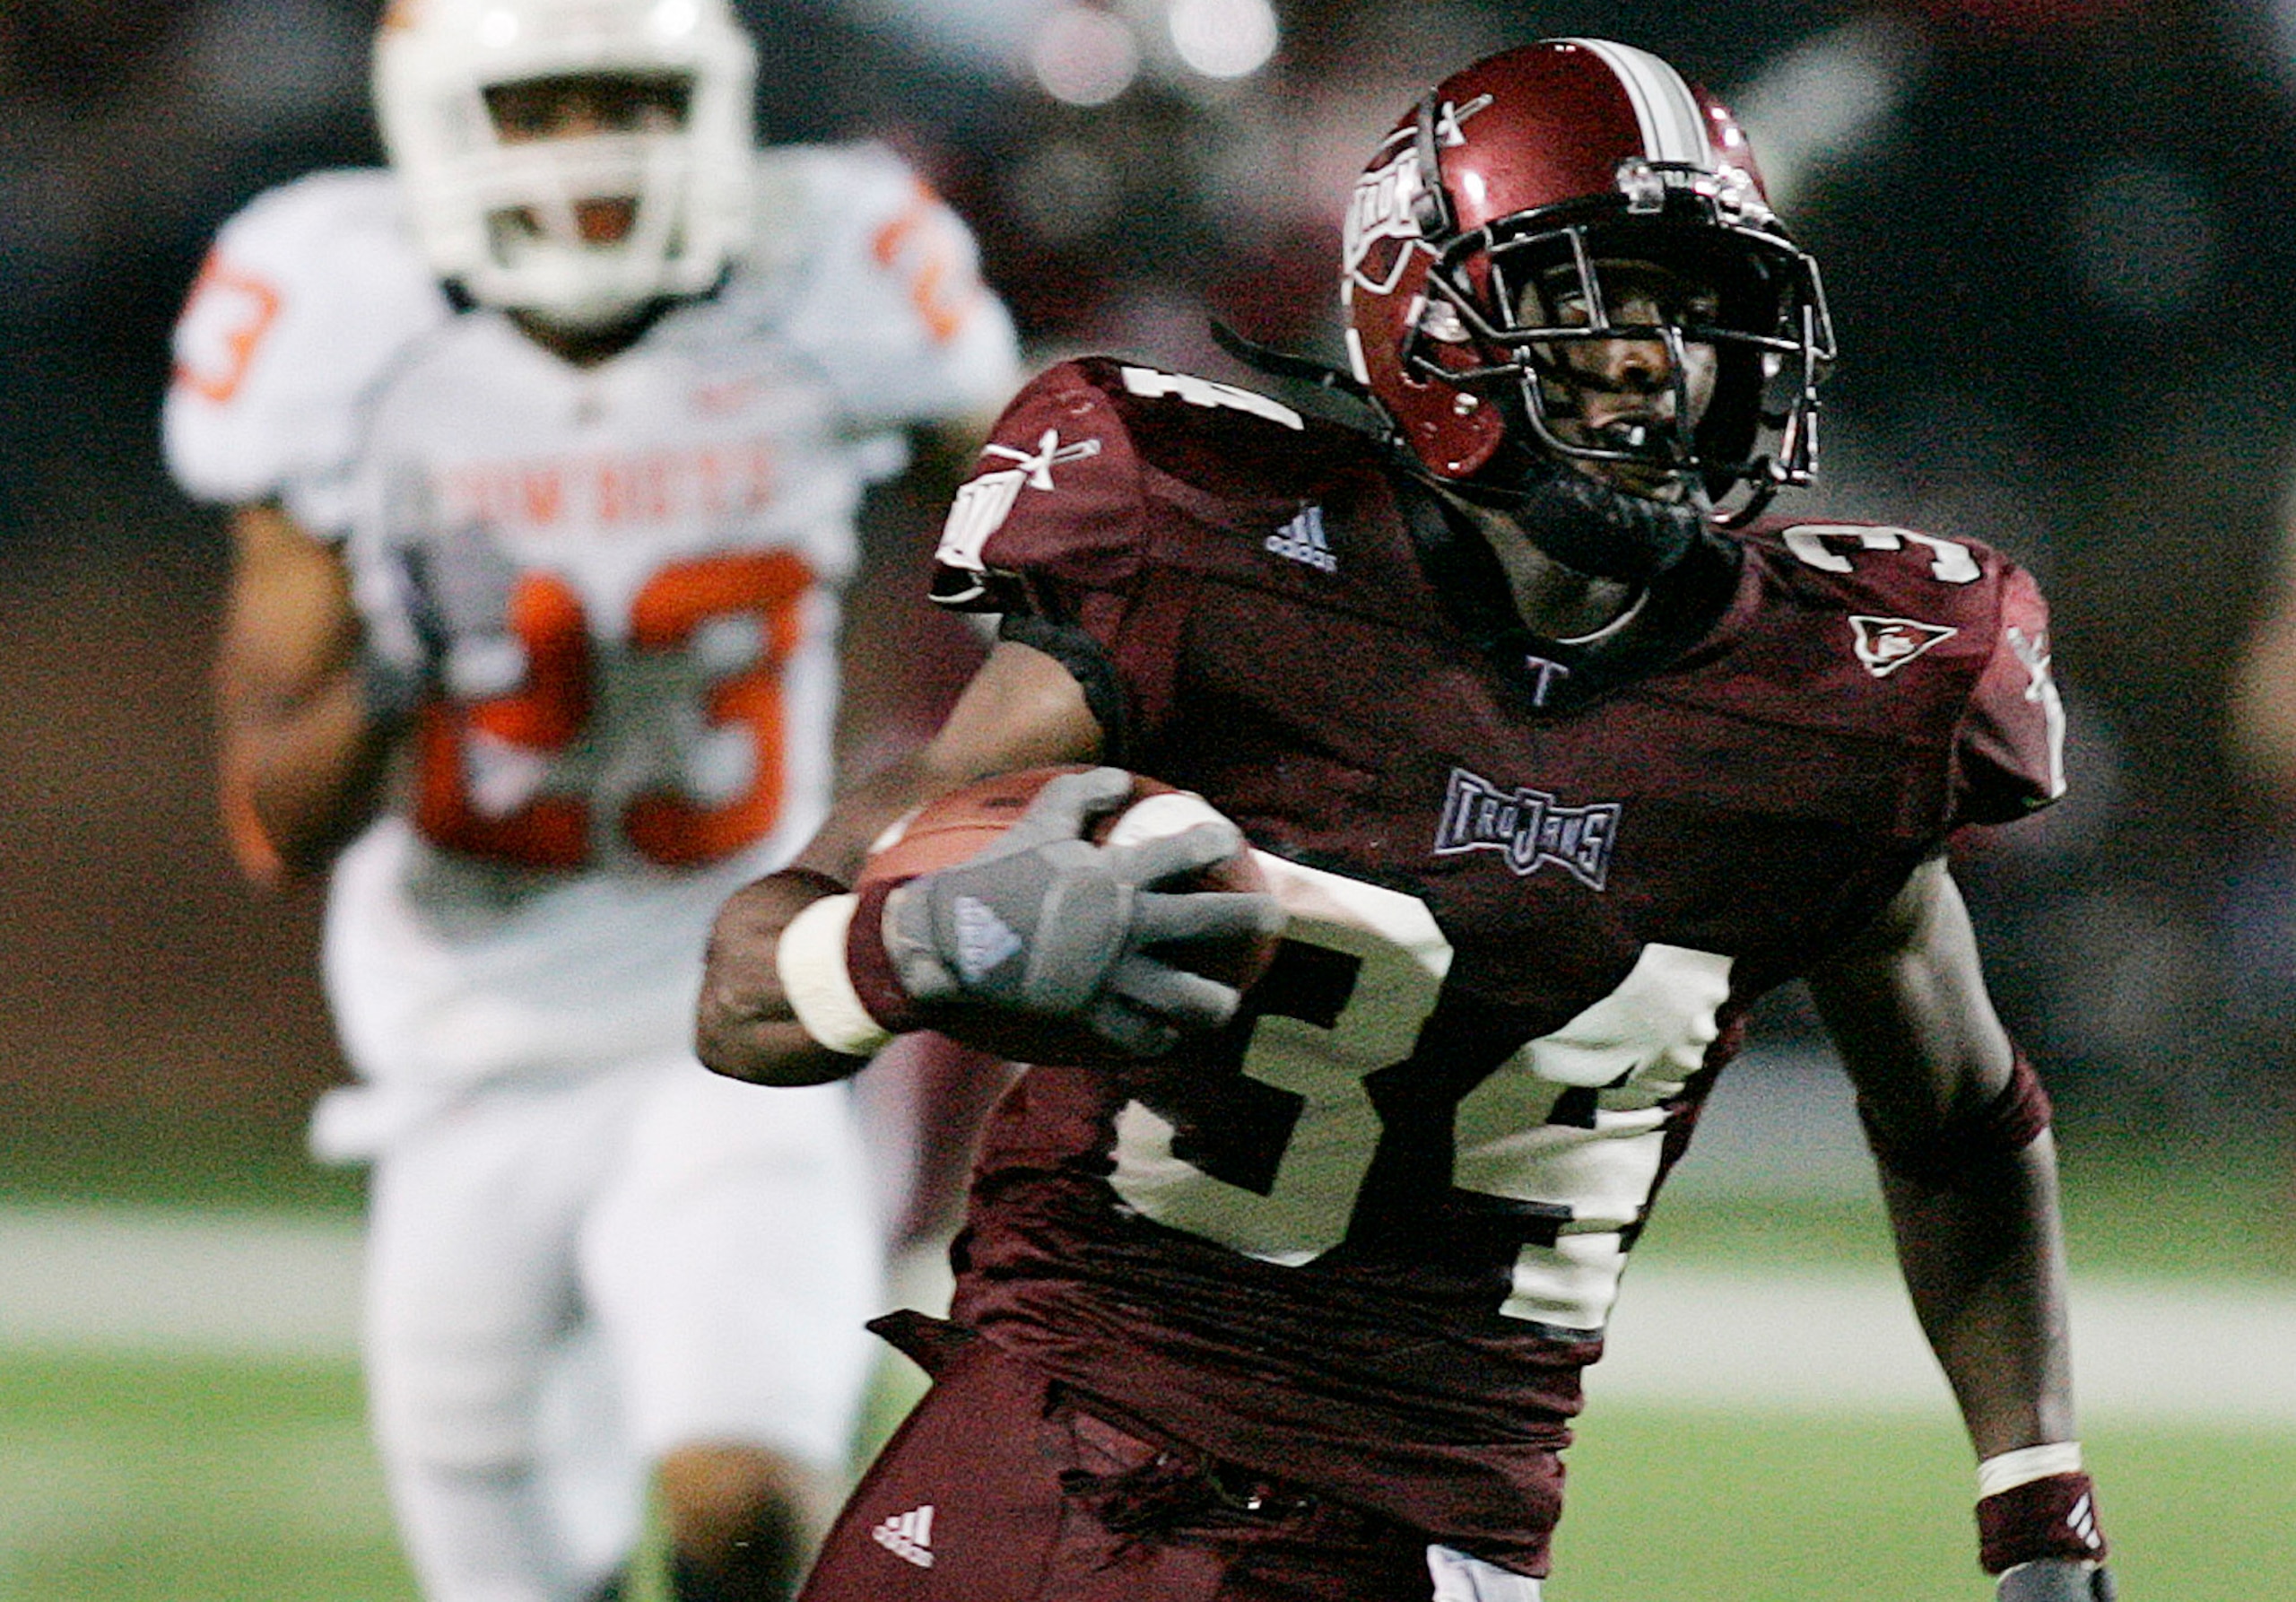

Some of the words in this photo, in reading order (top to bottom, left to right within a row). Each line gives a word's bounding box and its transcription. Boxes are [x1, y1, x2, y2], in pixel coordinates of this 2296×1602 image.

[414, 549, 814, 870] 23
[1526, 656, 1569, 707] T
[1105, 848, 1734, 1331] 34
